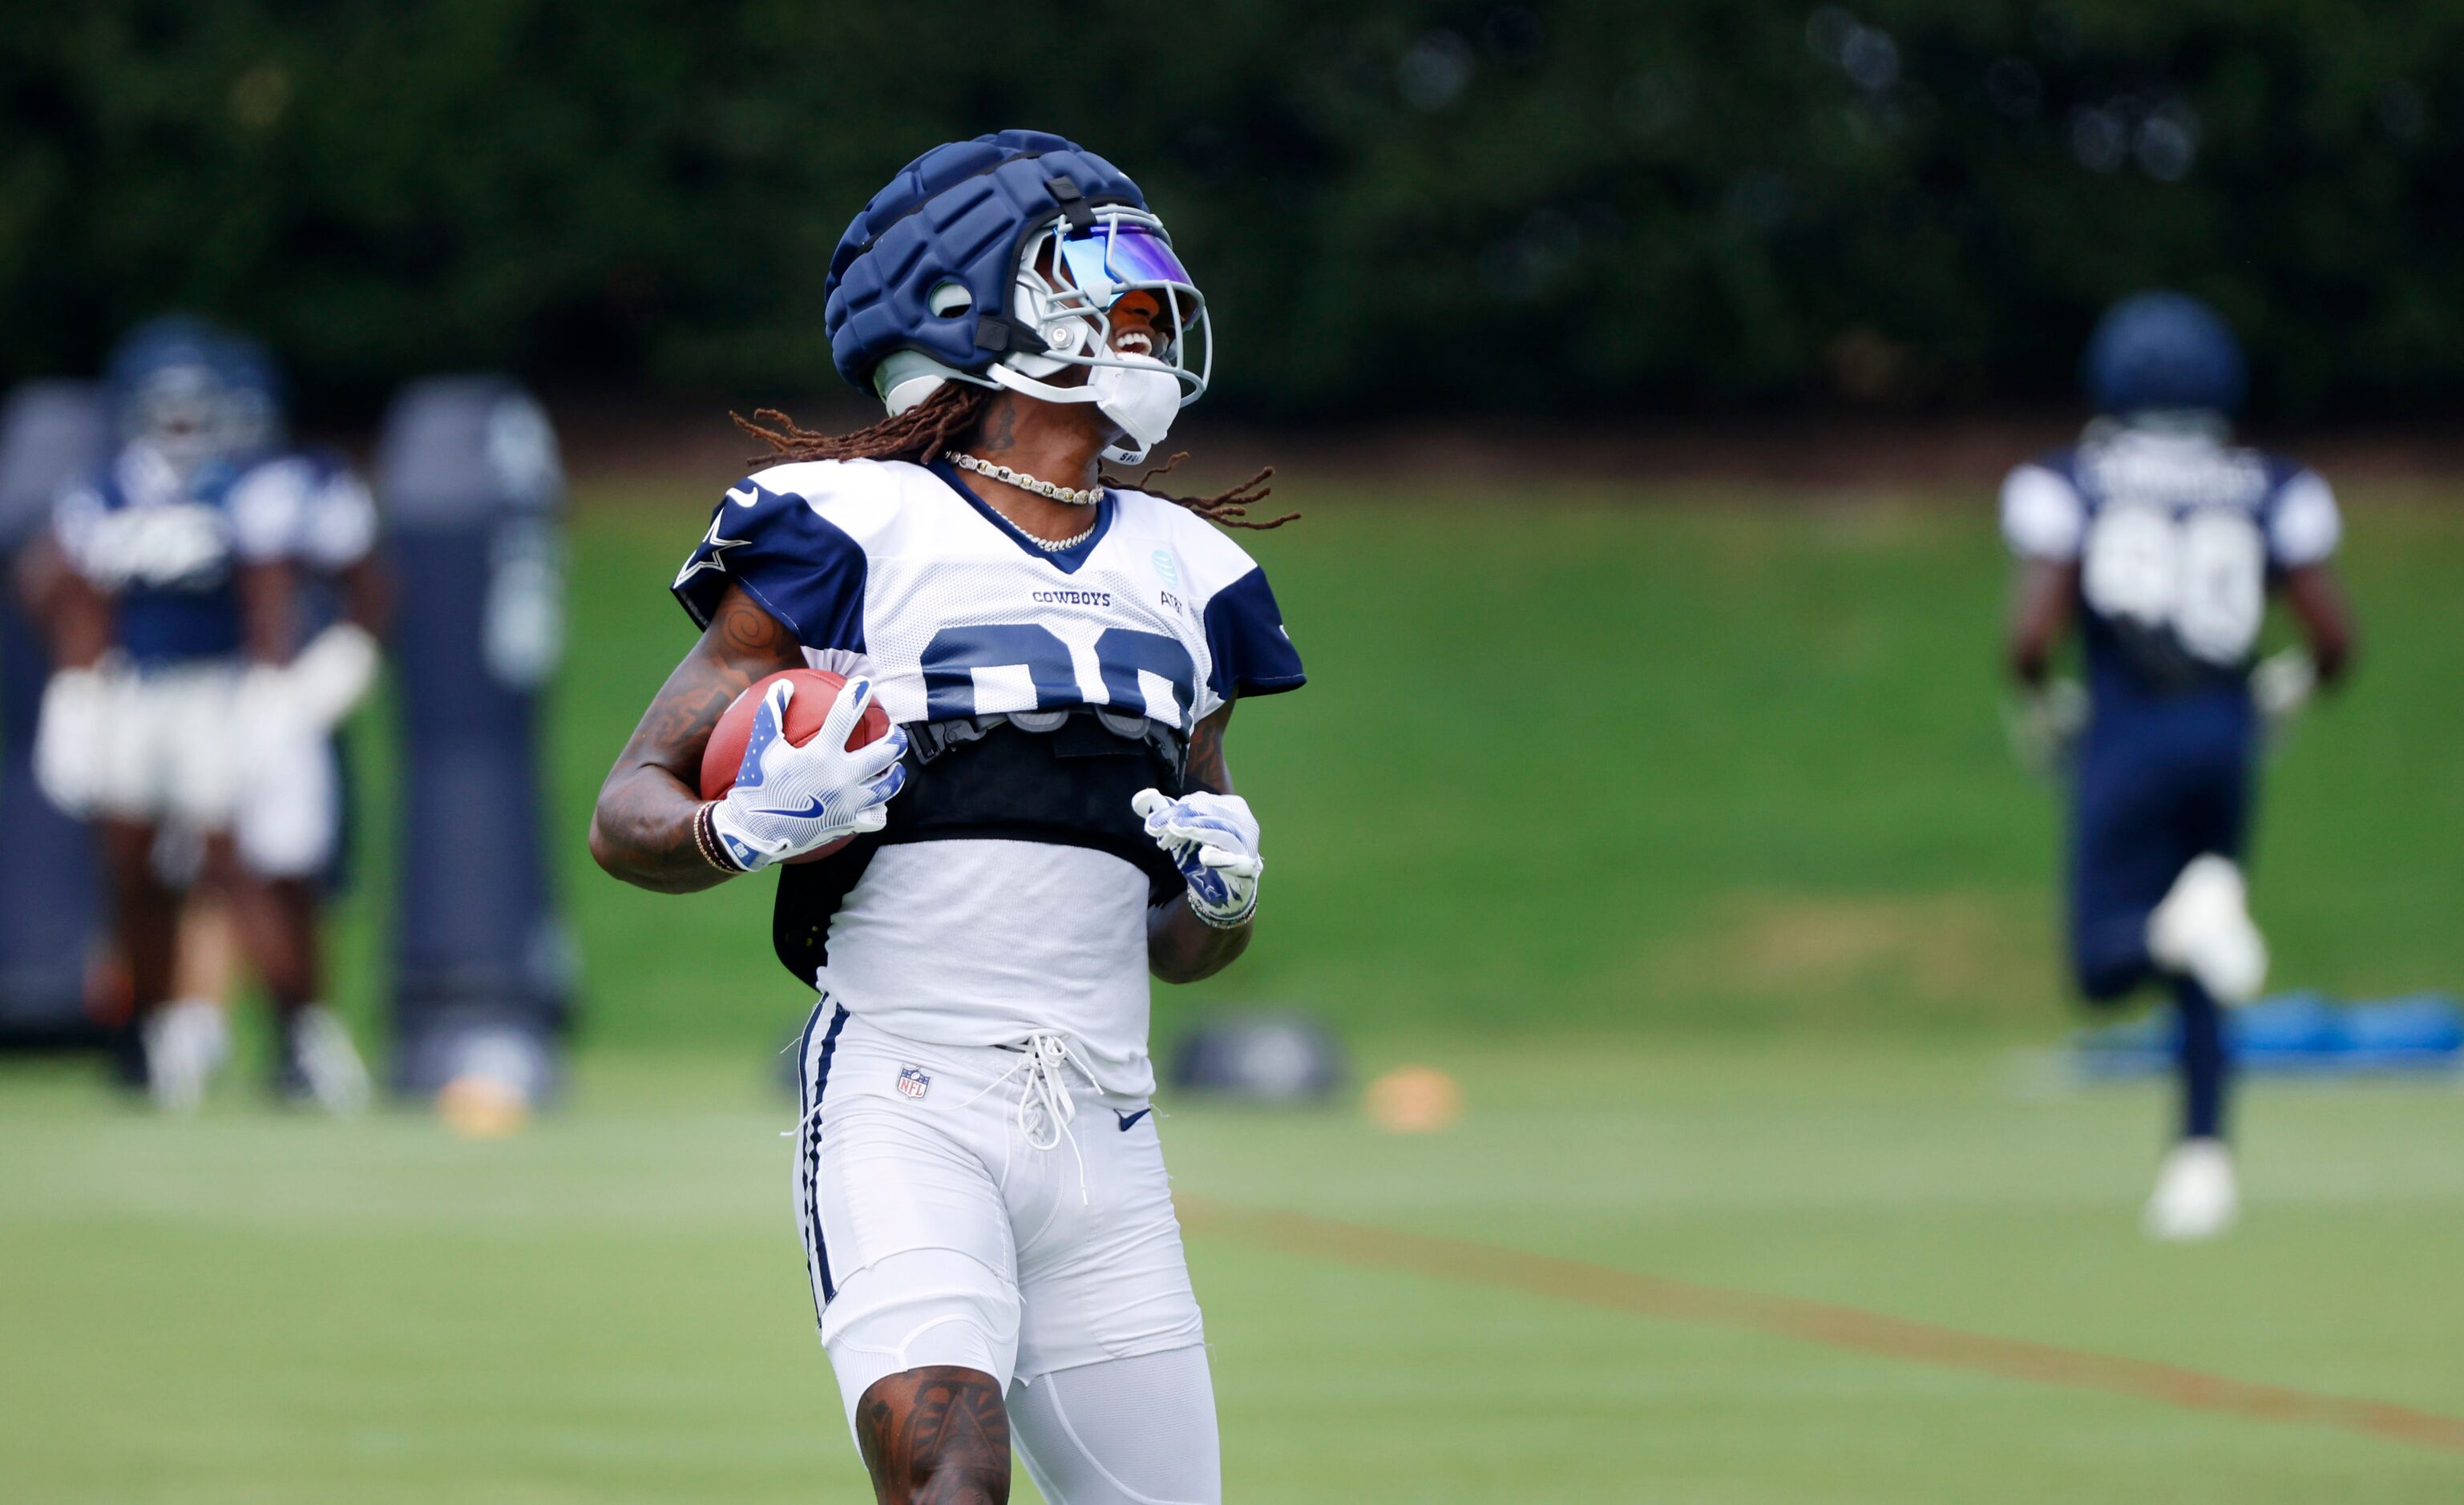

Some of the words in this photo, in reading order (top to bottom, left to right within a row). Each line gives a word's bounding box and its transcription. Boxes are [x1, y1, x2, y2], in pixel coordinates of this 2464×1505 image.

[1032, 591, 1111, 607] COWBOYS
[1161, 591, 1183, 617] AT&T
[899, 1078, 923, 1096] NFL
